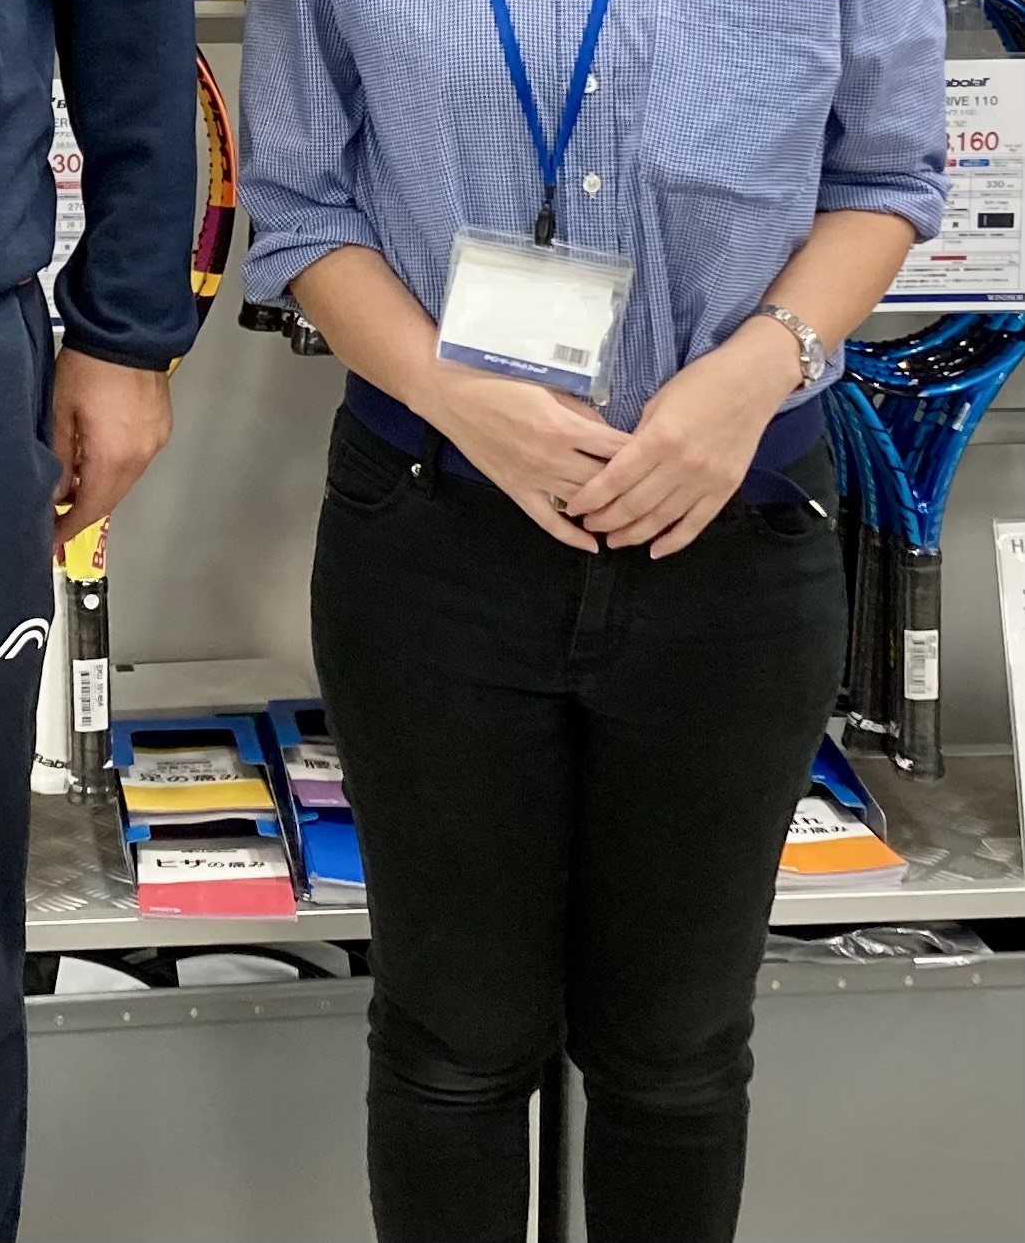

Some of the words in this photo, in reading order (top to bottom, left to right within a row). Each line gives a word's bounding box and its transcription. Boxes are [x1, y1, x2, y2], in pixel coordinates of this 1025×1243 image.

[974, 96, 998, 106] 110
[52, 154, 82, 174] 30
[986, 180, 1005, 188] 330
[987, 294, 1024, 302] WINDSOR
[156, 858, 265, 869] ヒザの痛み
